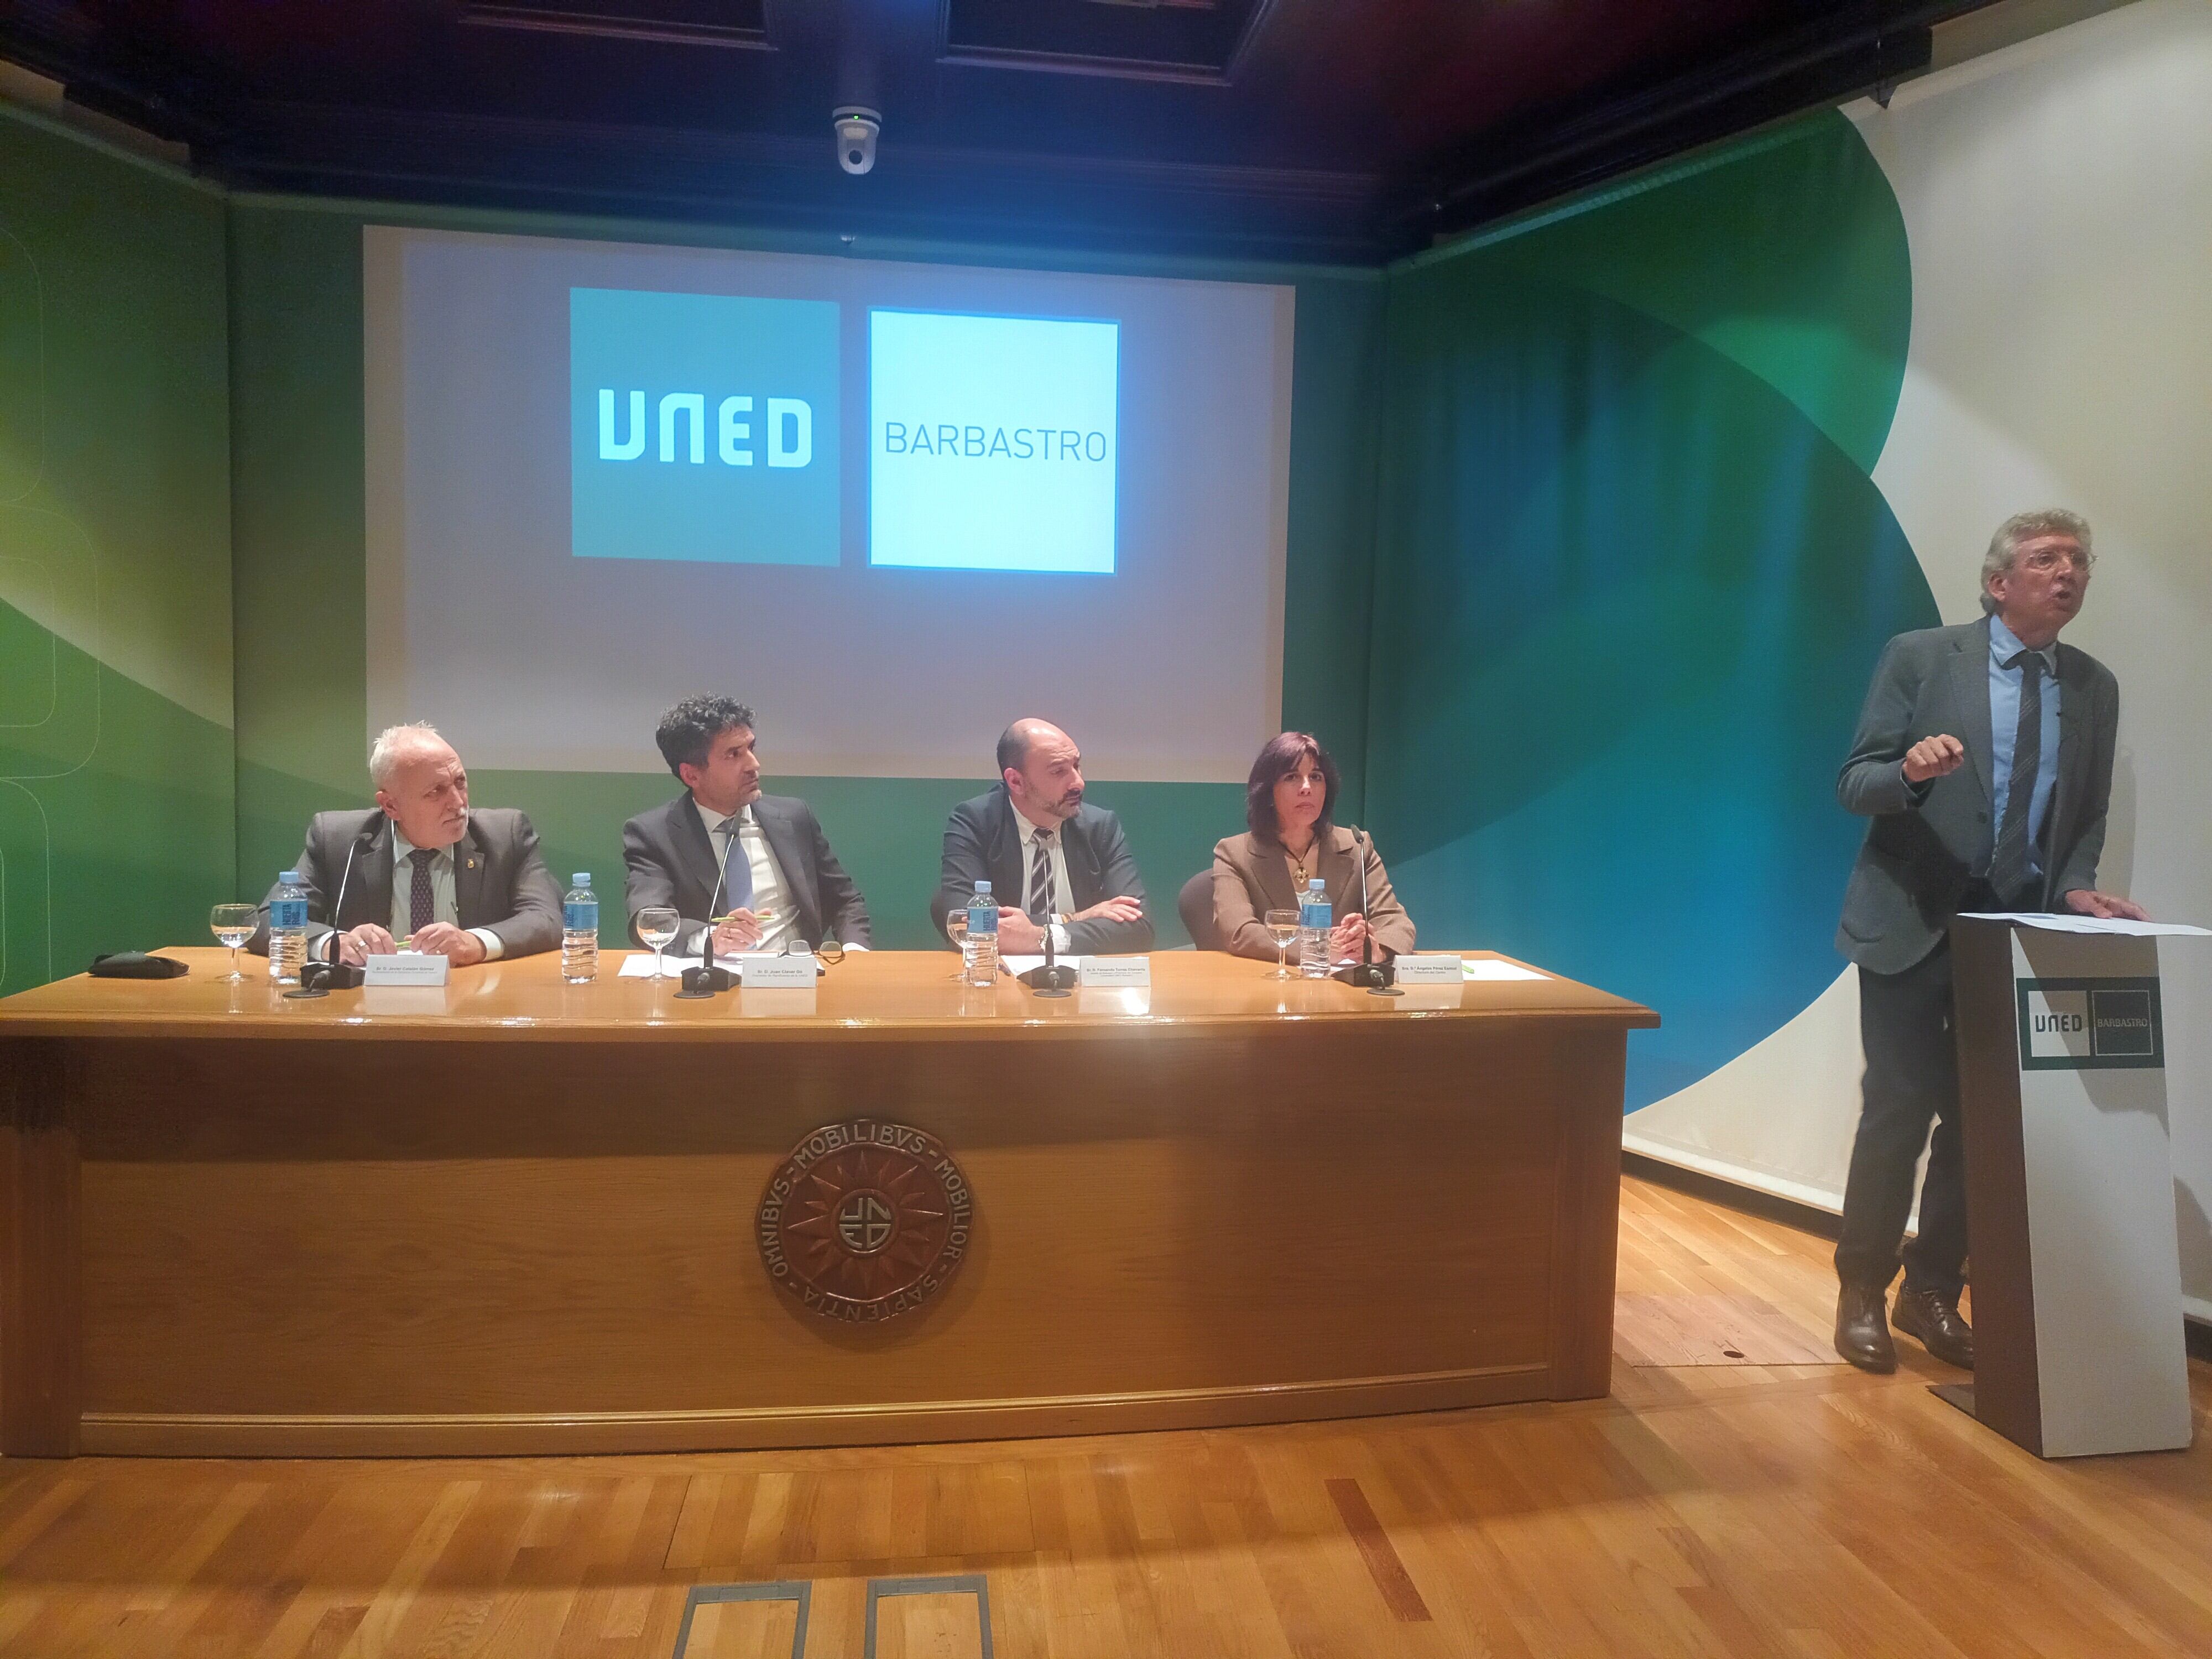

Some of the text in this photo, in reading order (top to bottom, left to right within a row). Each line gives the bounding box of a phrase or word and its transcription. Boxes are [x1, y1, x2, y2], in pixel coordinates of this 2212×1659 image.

[598, 388, 813, 468] UNED
[885, 421, 1107, 462] BARBASTRO
[2035, 1014, 2083, 1032] UNED
[2098, 1018, 2148, 1027] BARBASTRO
[761, 1123, 968, 1320] OMNIBVS MOBILIBVS MOBILIOR SAPIENTIA
